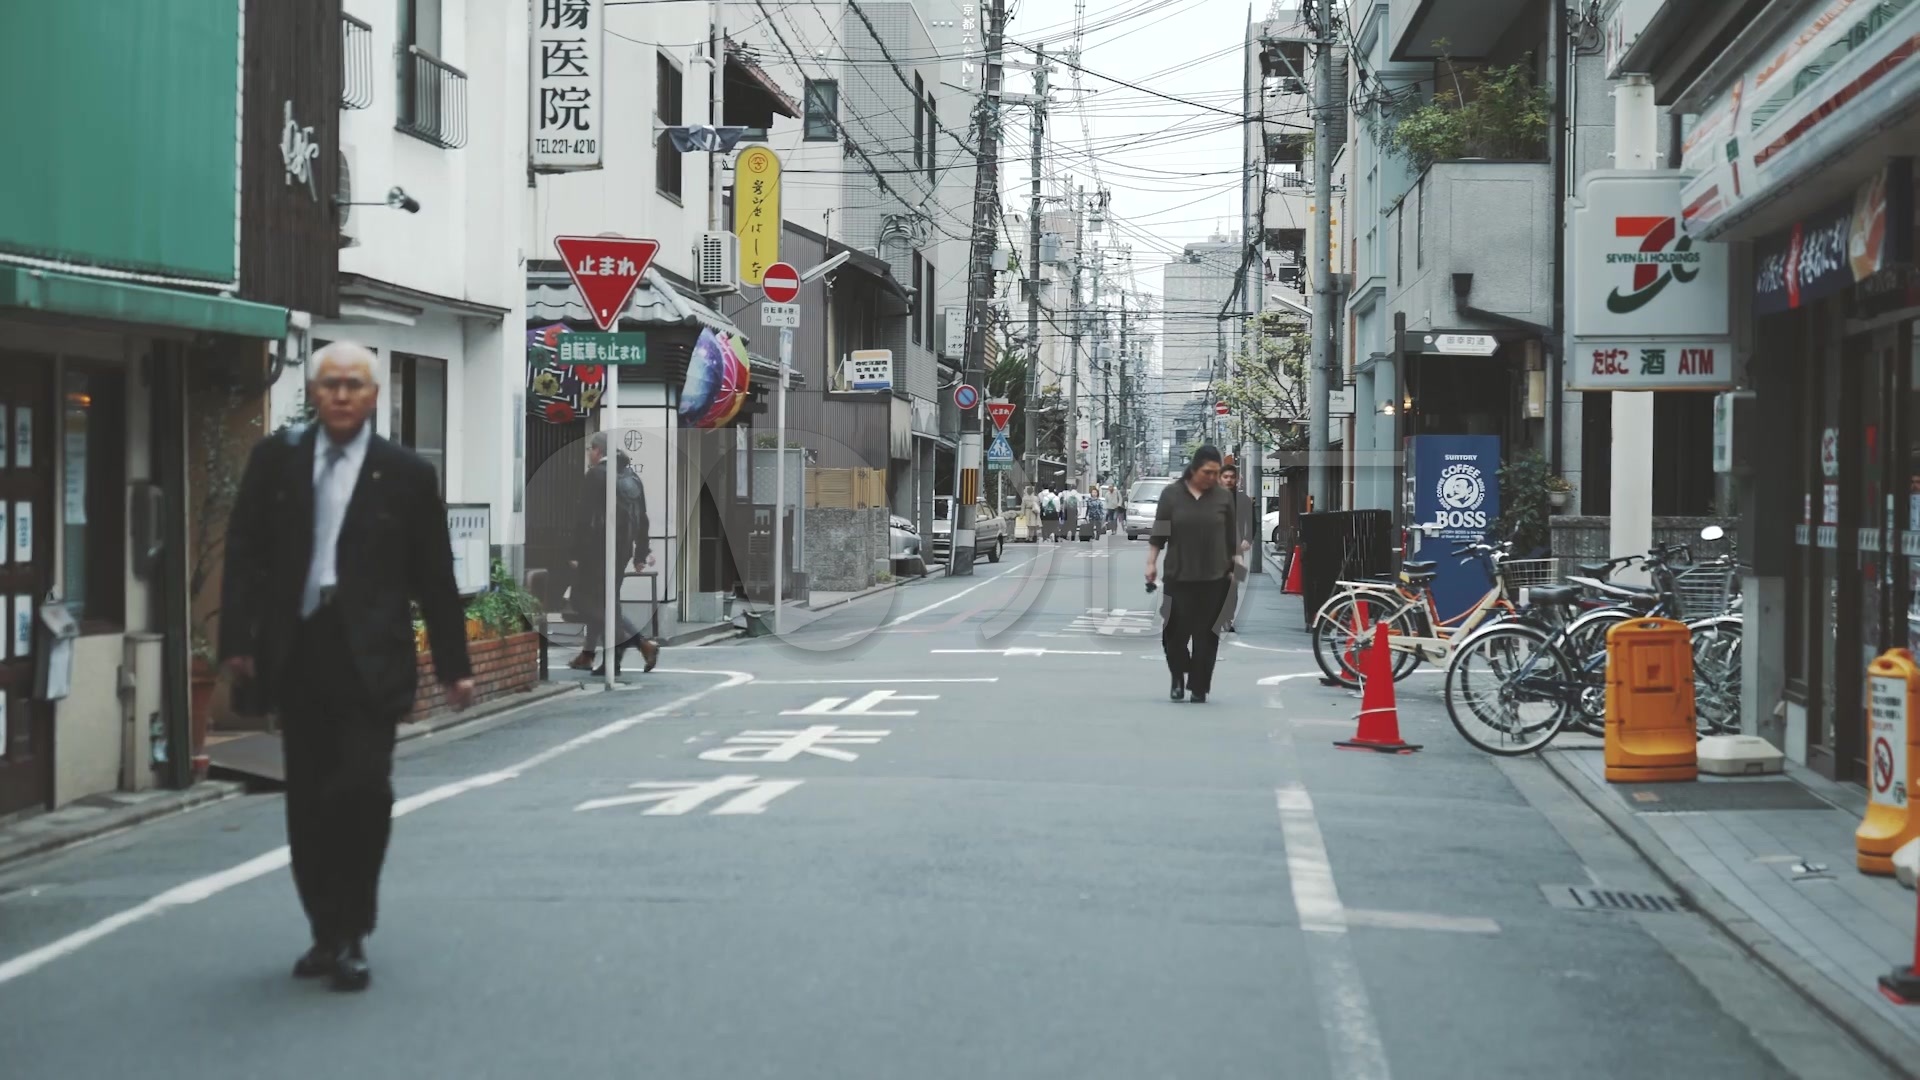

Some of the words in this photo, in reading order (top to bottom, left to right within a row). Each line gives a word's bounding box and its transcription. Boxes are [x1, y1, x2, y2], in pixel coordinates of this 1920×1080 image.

[576, 255, 637, 276] 止まれ
[1650, 252, 1700, 263] HOLDINGS
[560, 341, 641, 361] 自転車も止まれ
[1592, 349, 1629, 375] たばこ
[1640, 349, 1665, 375] 酒
[1678, 349, 1714, 375] ATM
[1441, 464, 1481, 478] COFFEE
[1435, 510, 1487, 528] BOSS
[574, 690, 941, 815] 止まれ
